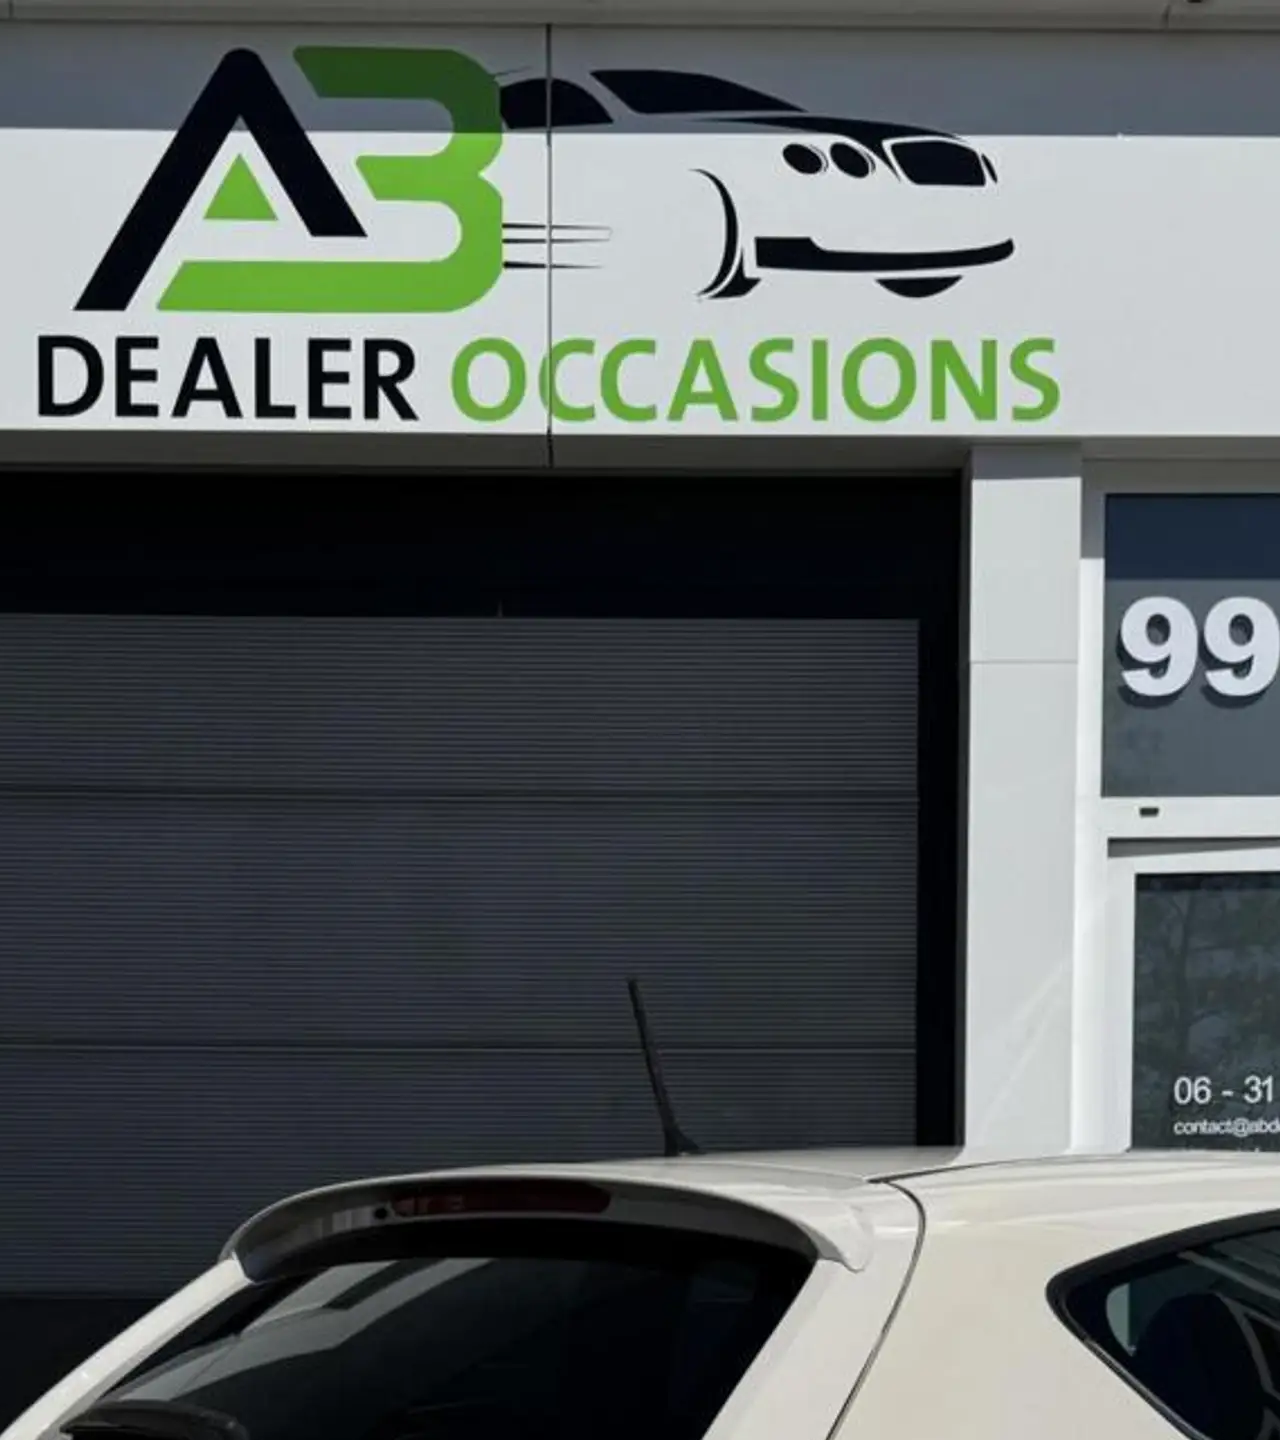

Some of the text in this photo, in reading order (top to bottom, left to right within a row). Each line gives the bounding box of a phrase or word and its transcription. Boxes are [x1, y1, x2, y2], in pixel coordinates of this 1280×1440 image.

[73, 45, 503, 313] AB
[37, 334, 1061, 423] DEALER OCCASIONS
[1174, 1076, 1212, 1104] 06
[1244, 1075, 1273, 1103] 31
